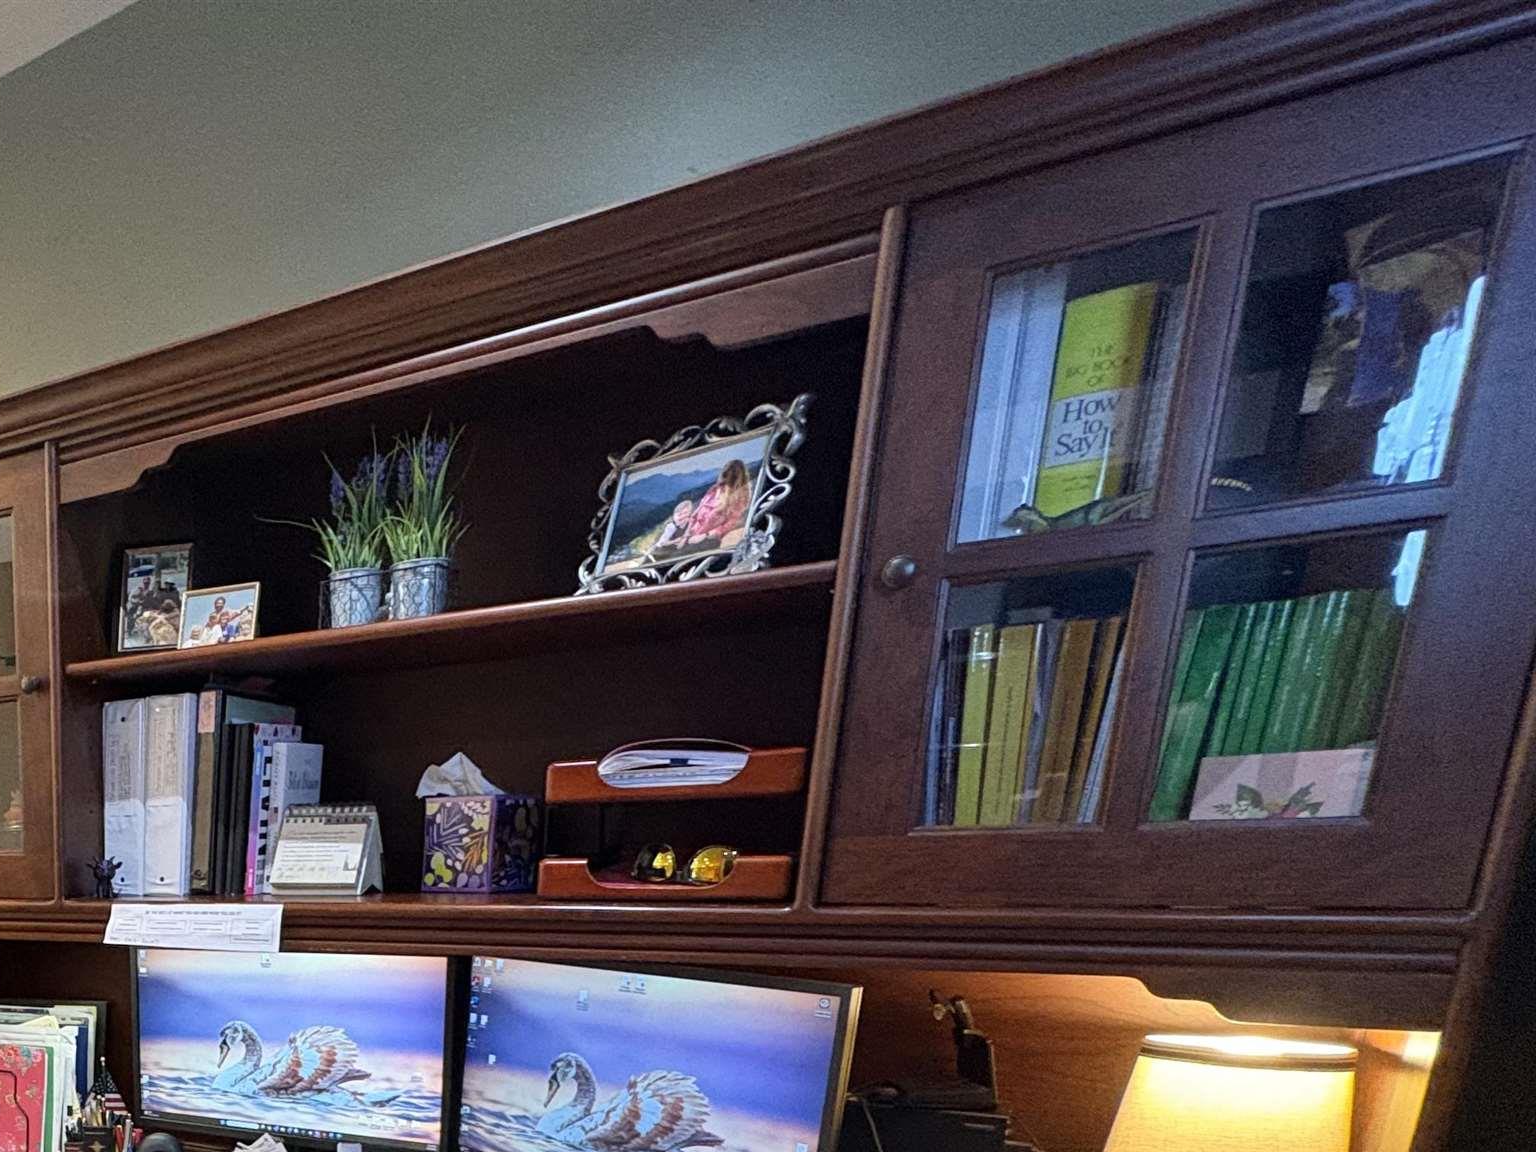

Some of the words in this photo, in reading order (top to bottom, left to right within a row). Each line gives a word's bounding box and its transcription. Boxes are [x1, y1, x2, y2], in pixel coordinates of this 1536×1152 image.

[1062, 395, 1121, 424] How
[1082, 420, 1103, 435] to
[1054, 433, 1099, 458] Say
